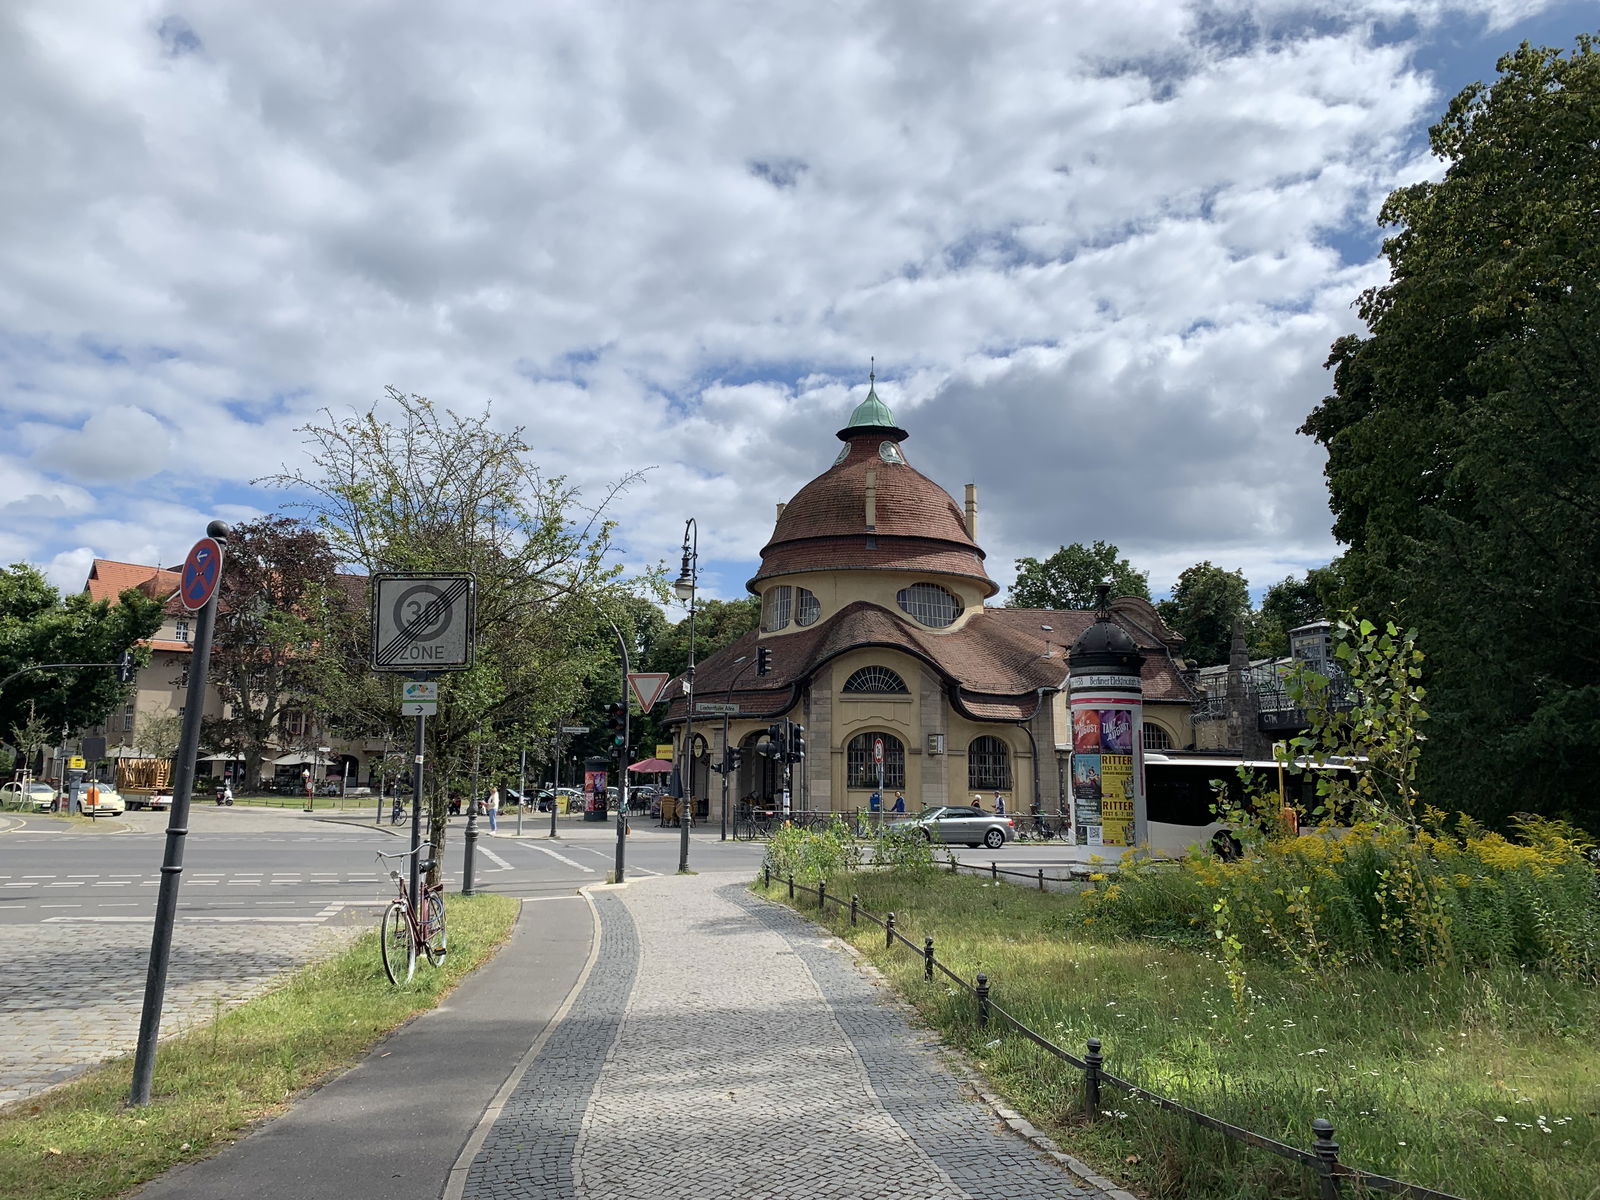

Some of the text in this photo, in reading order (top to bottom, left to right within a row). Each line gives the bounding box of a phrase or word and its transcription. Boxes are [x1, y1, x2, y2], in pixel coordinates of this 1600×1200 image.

[399, 645, 445, 660] ZONE
[1102, 717, 1117, 734] TANZ
[1106, 722, 1130, 742] AUGUST
[1102, 755, 1133, 765] RITTER
[1103, 801, 1134, 811] RITTER
